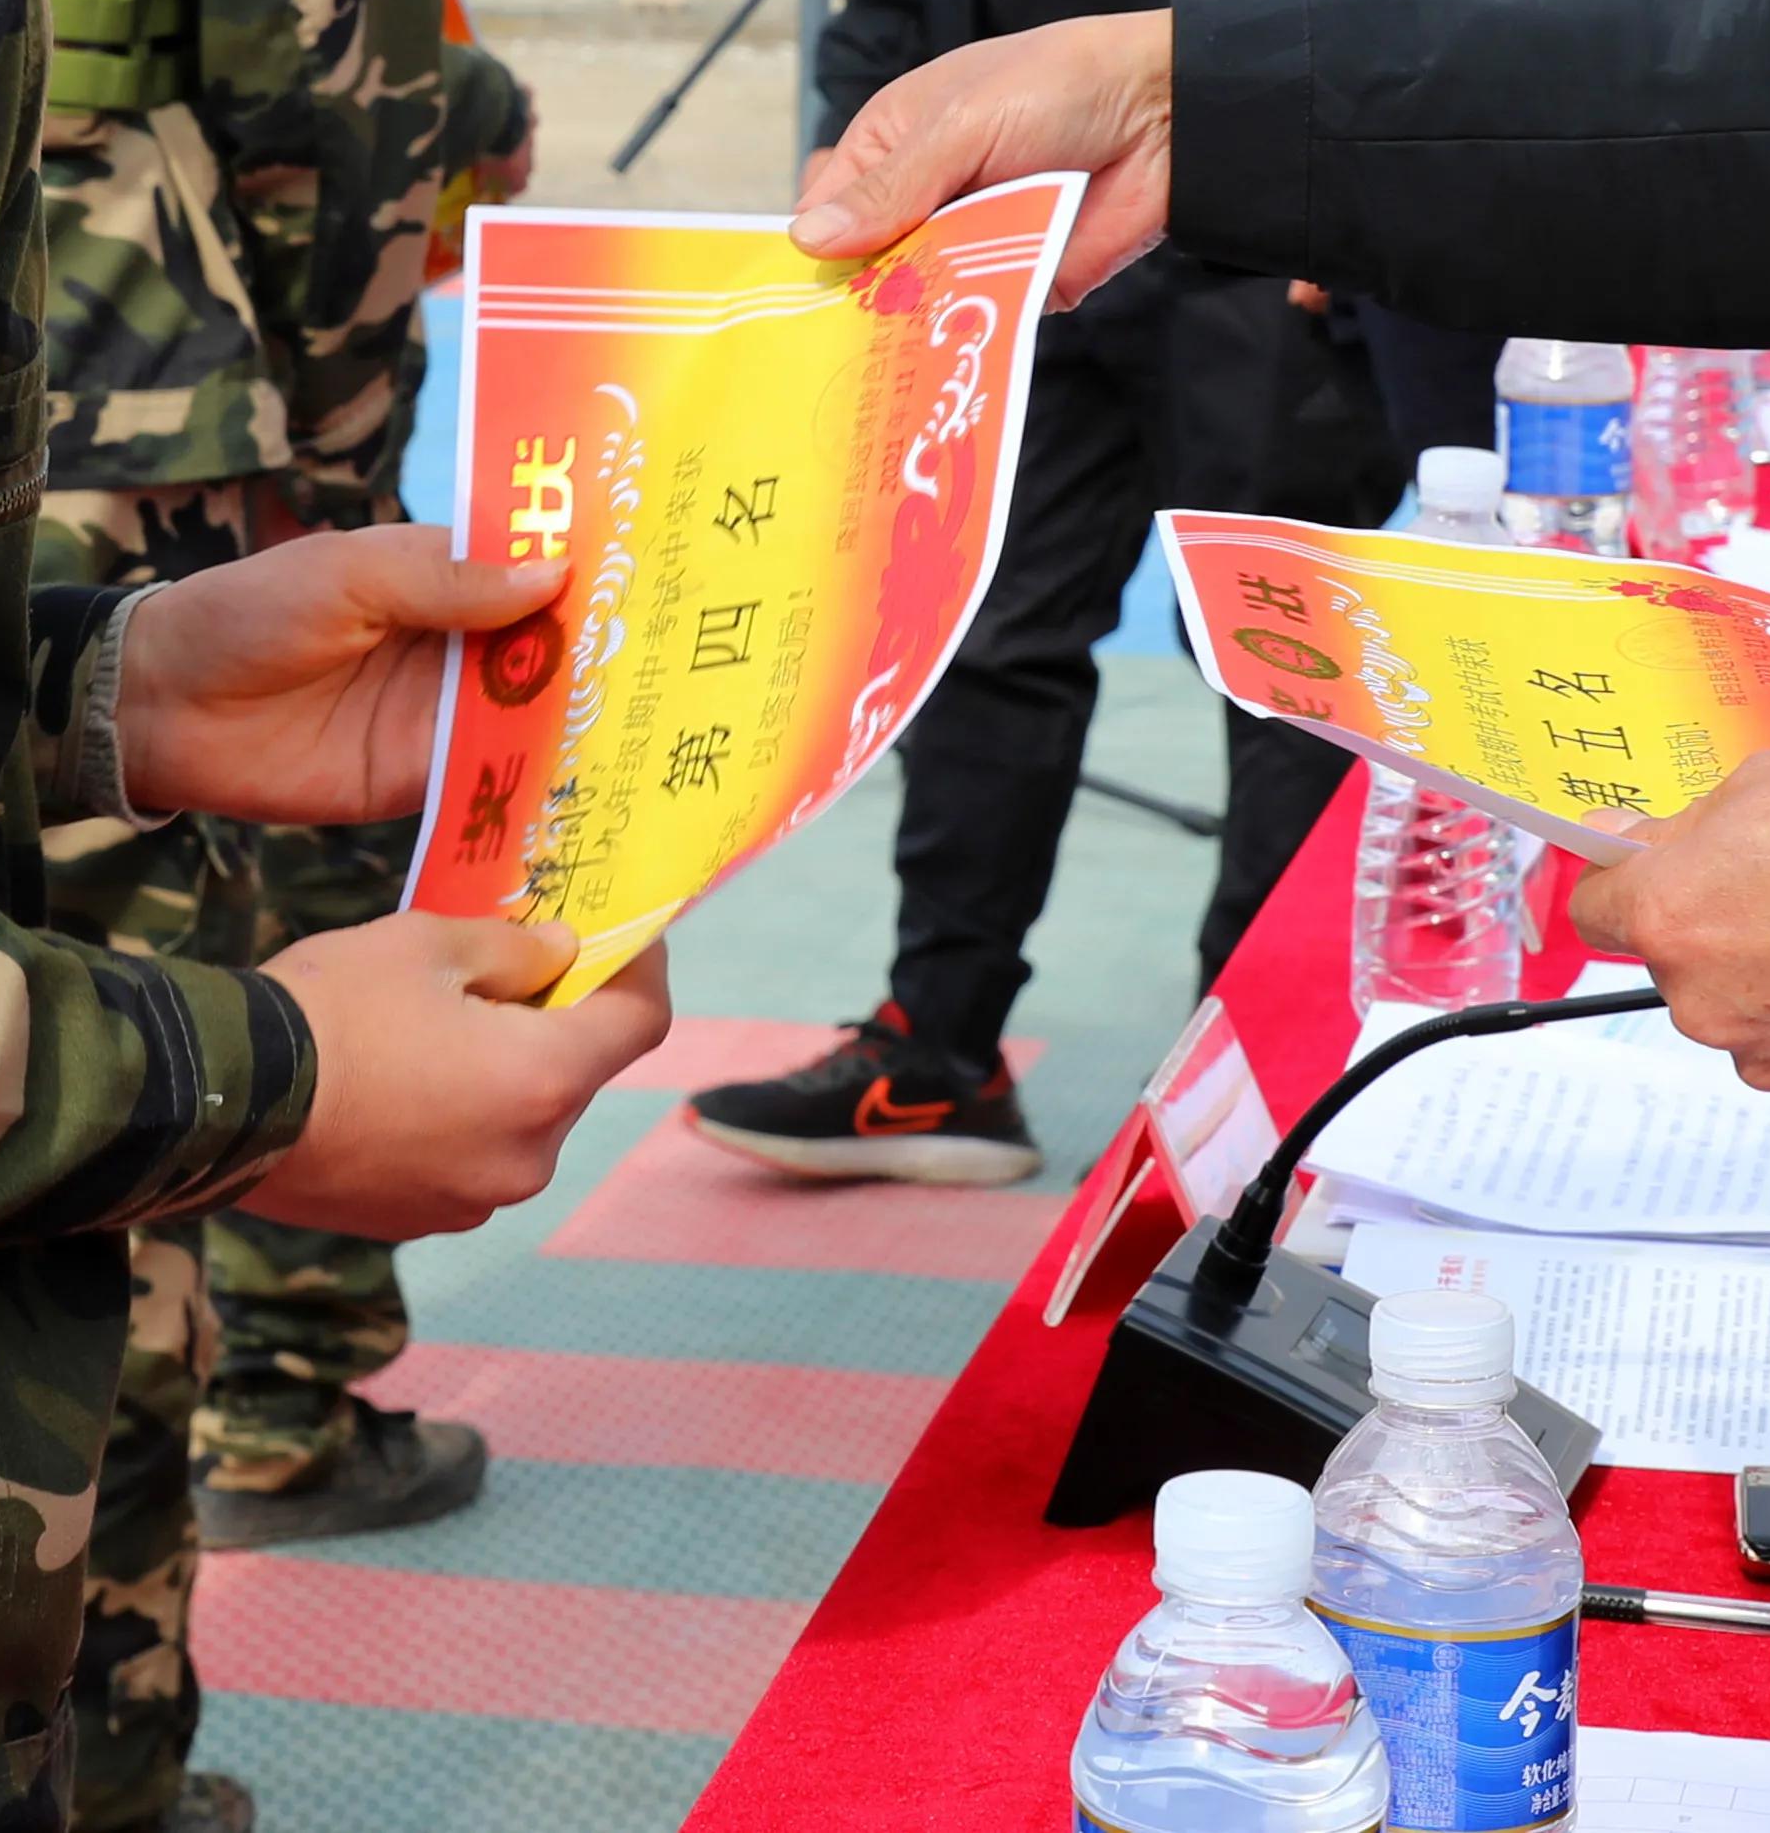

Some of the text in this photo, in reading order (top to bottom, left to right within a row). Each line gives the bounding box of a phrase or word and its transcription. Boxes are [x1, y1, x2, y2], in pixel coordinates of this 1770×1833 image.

[509, 435, 577, 560] 状
[659, 474, 781, 800] 第四名
[1236, 570, 1314, 628] 状
[1526, 668, 1653, 818] 第五名
